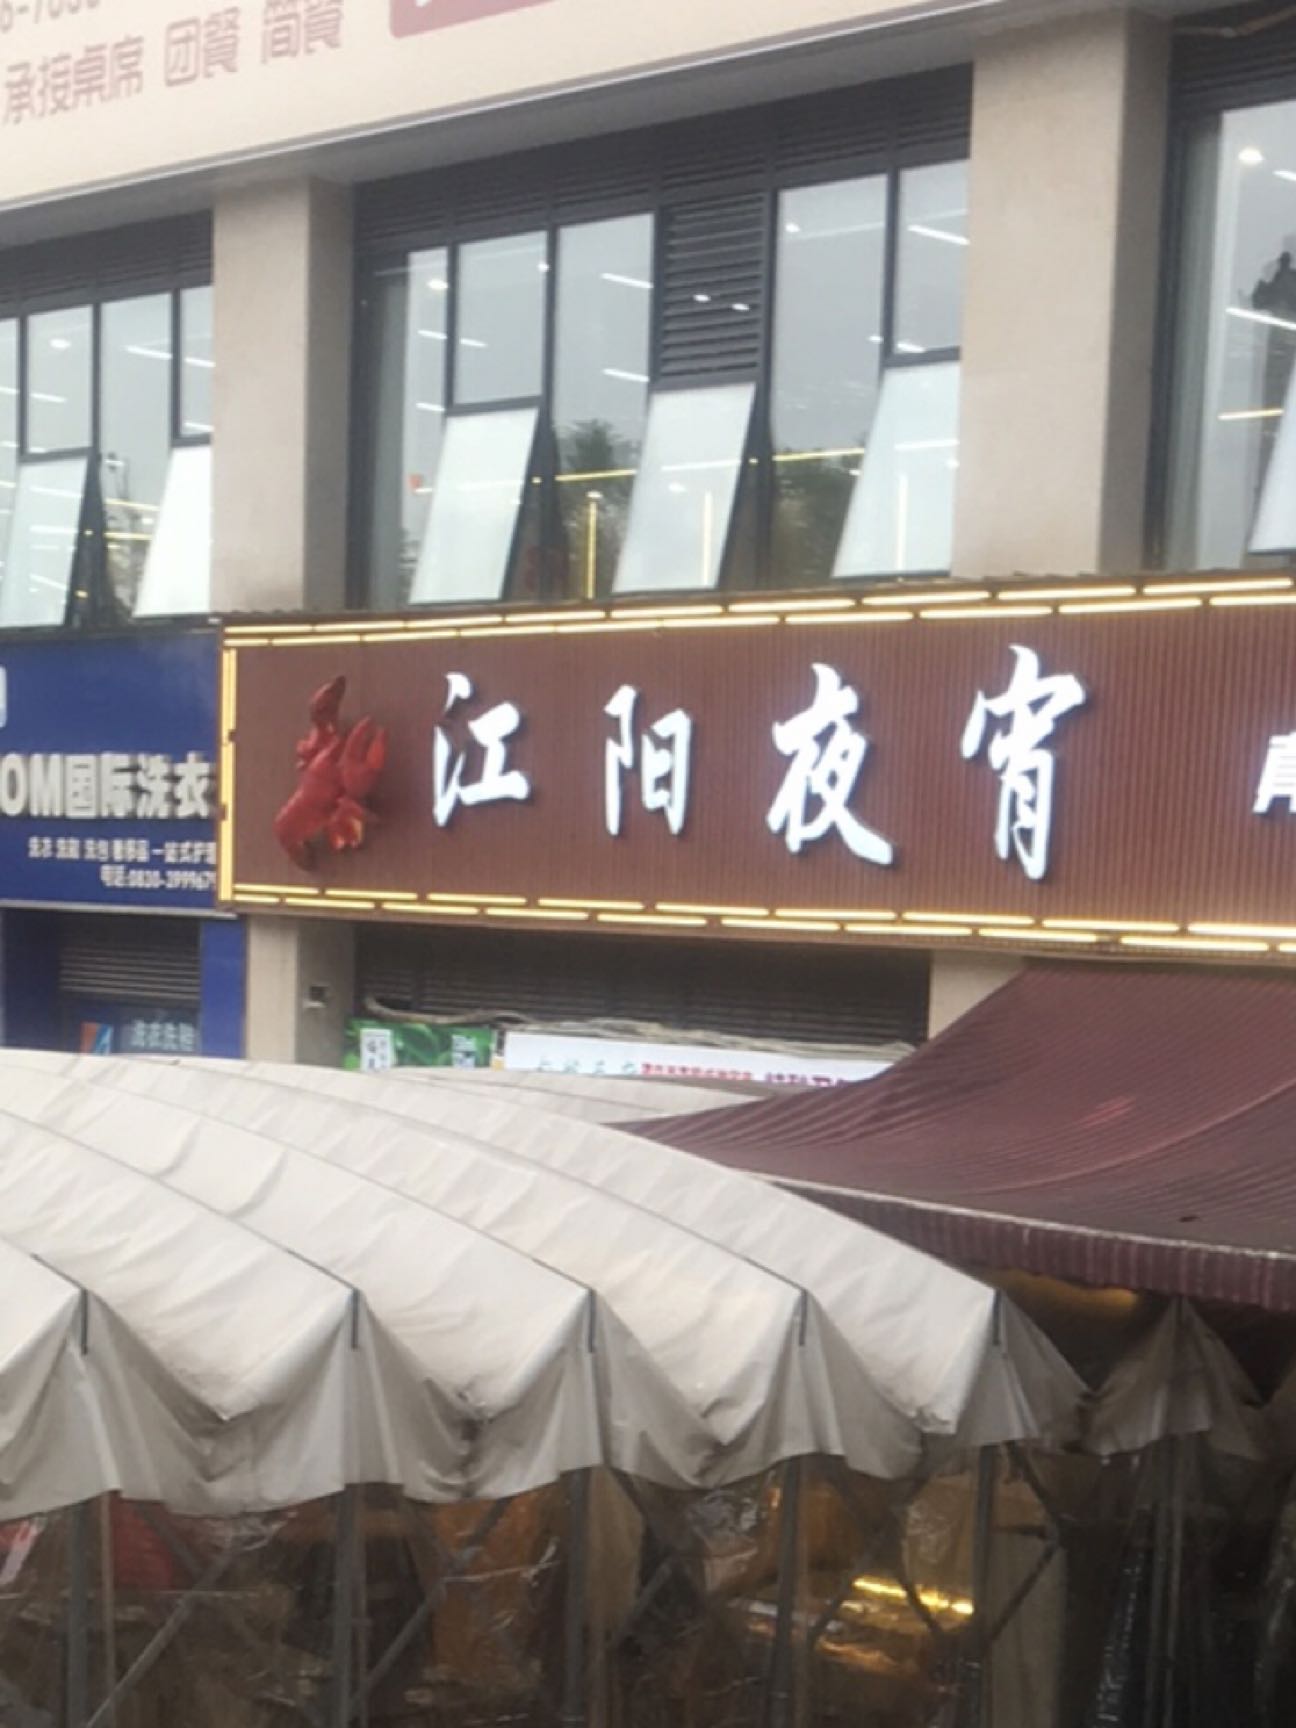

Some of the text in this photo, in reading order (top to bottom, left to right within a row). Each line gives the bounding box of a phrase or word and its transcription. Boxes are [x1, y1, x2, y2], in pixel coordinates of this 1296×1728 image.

[3, 35, 145, 124] 承接桌席
[164, 6, 242, 87] 团餐
[260, 0, 345, 63] 简餐
[432, 645, 1086, 881] 江阳夜宵
